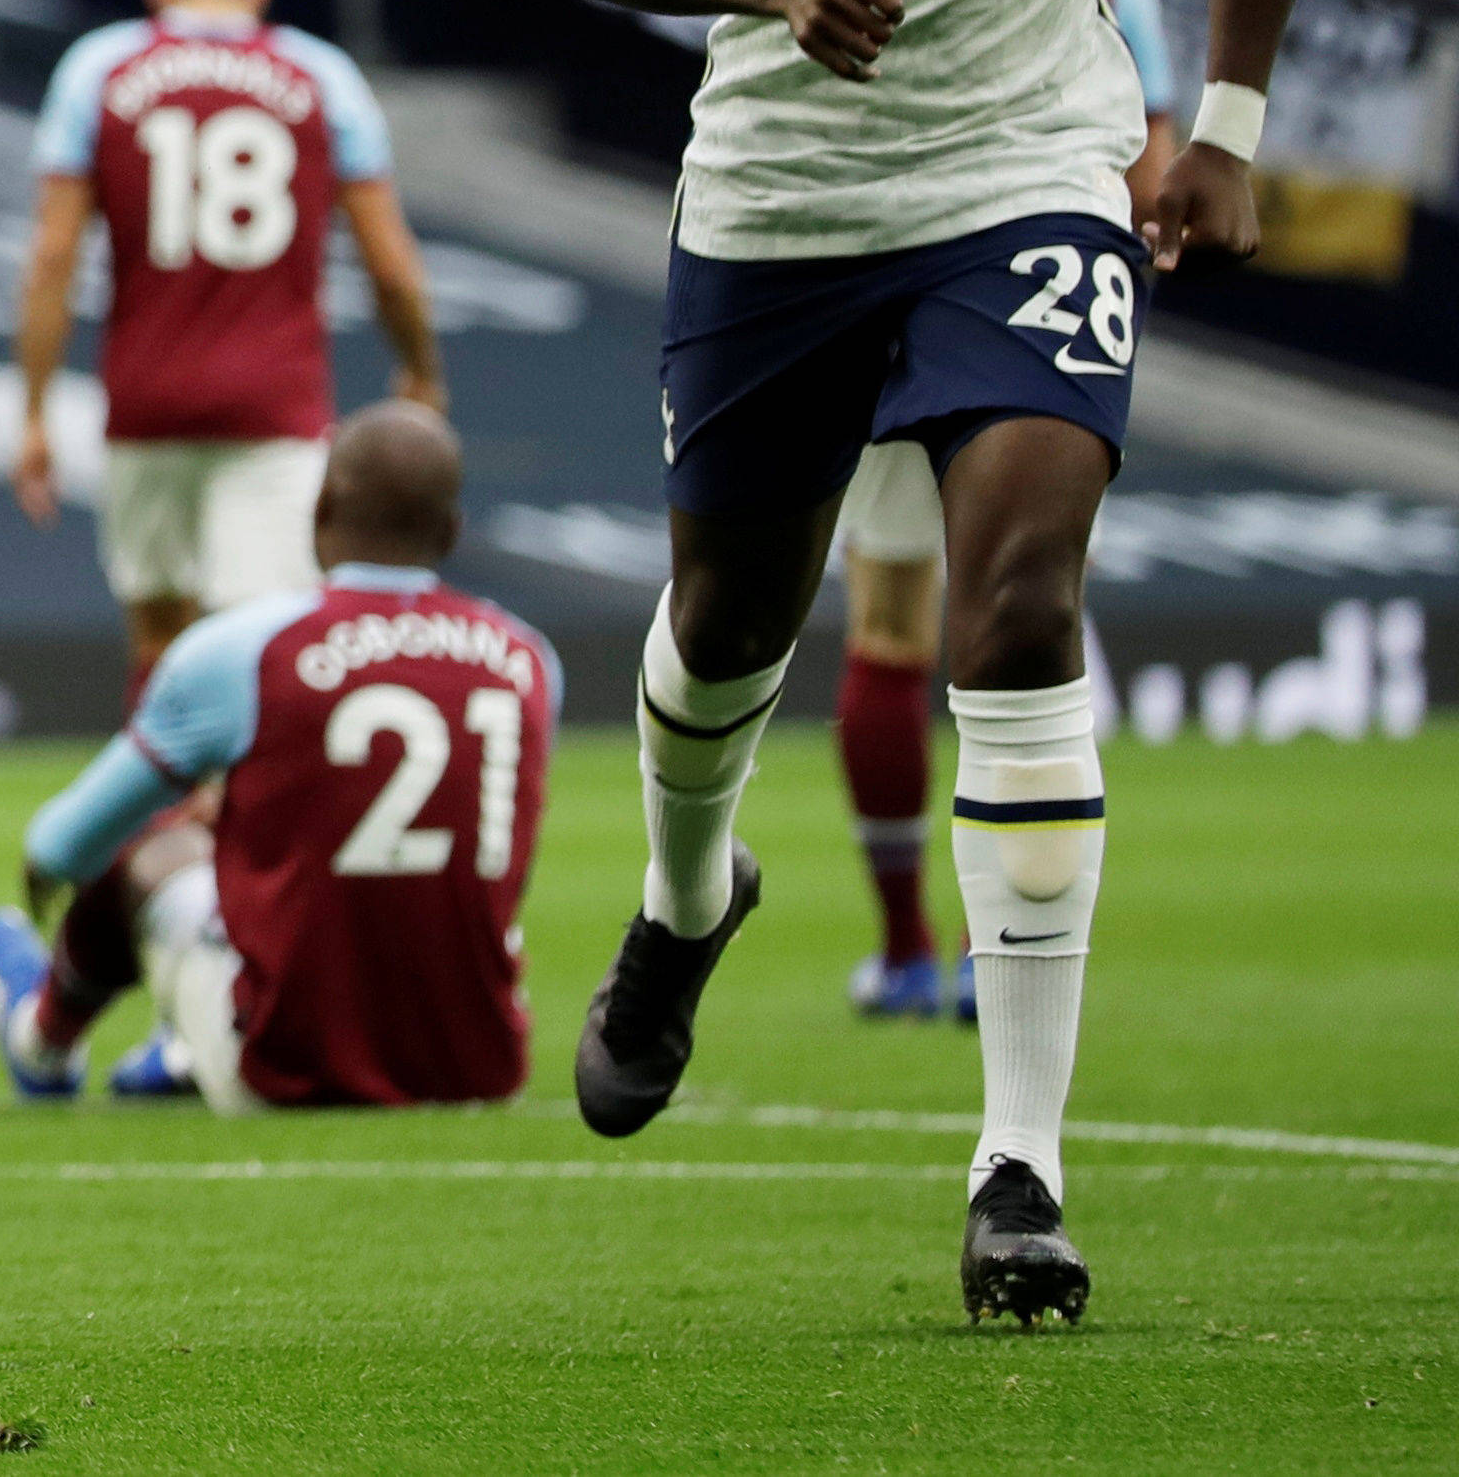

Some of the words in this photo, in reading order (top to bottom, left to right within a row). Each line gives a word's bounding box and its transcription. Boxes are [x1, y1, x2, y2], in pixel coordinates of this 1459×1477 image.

[136, 104, 298, 272] 18
[1007, 244, 1134, 367] 28
[294, 611, 534, 695] OGBONNA
[324, 682, 523, 881] 21
